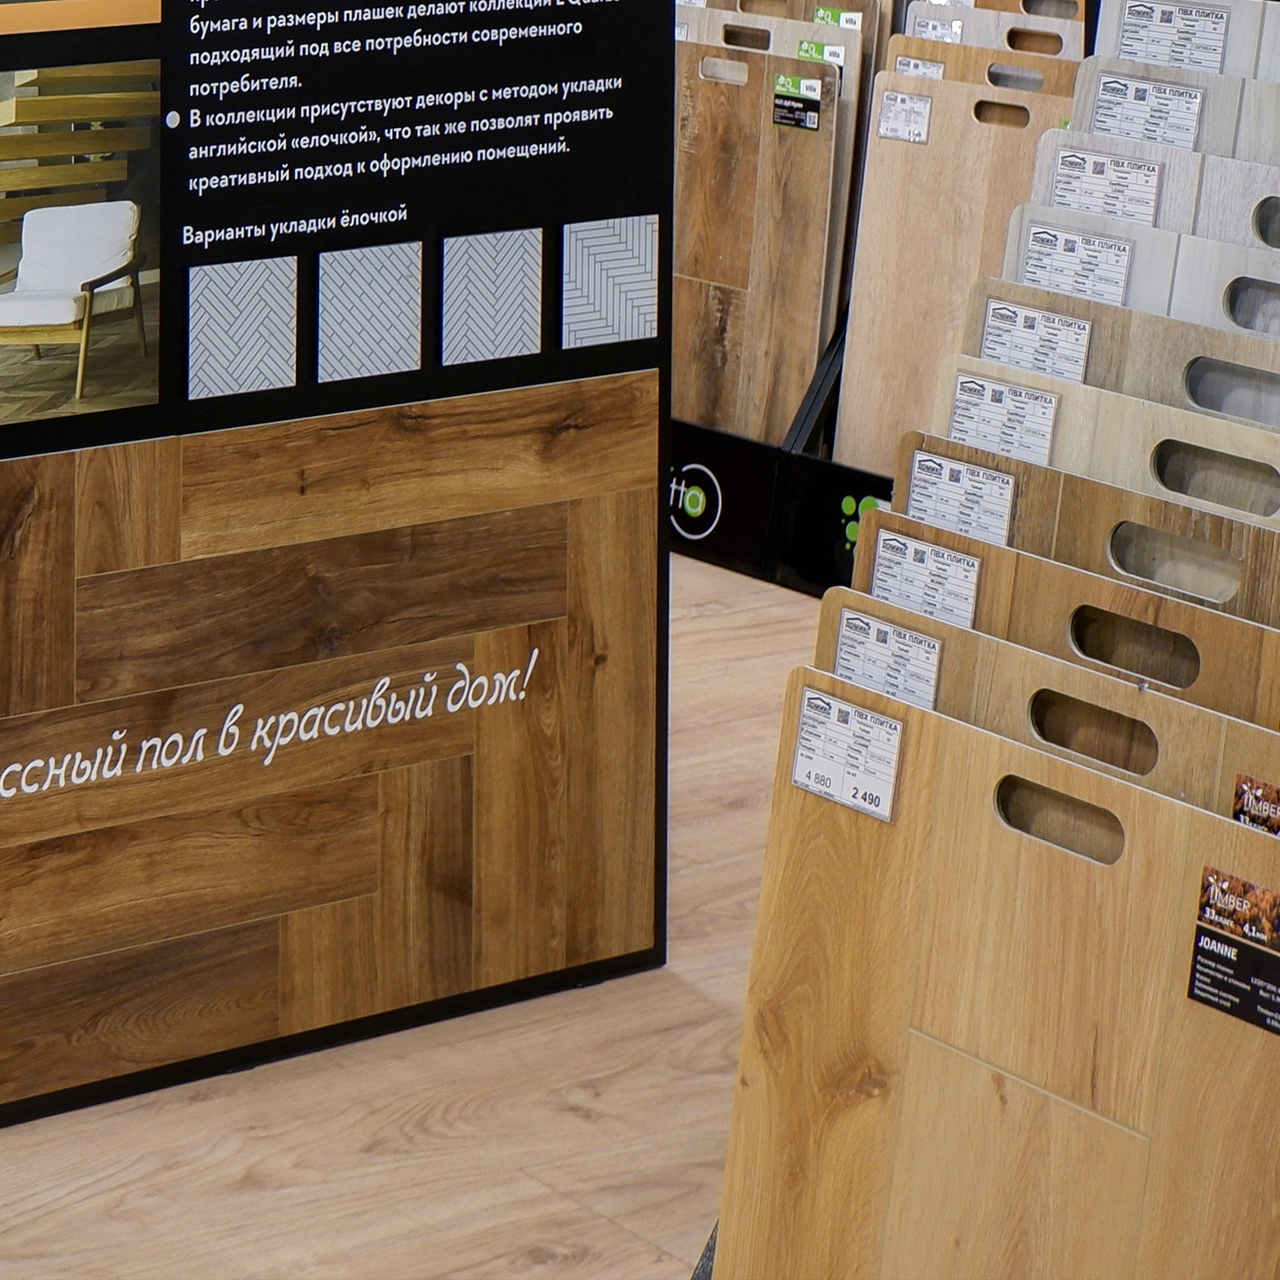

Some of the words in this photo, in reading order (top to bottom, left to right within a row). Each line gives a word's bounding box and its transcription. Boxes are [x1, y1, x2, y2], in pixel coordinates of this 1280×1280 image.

[1178, 8, 1193, 16] ПВХ
[1194, 10, 1224, 20] ПЛИТКА
[1110, 160, 1125, 168] ПВХ
[1127, 162, 1156, 173] ПЛИТКА
[182, 223, 266, 248] Варианты
[270, 214, 337, 241] укладки
[340, 203, 408, 229] ёлочкой
[135, 719, 208, 774] пол
[216, 704, 244, 758] в
[250, 674, 439, 766] красивый
[446, 648, 539, 715] дом!
[854, 710, 868, 720] ПВХ
[870, 716, 898, 732] ПЛИТКА
[861, 792, 880, 807] 490
[1198, 936, 1238, 961] JOANNE
